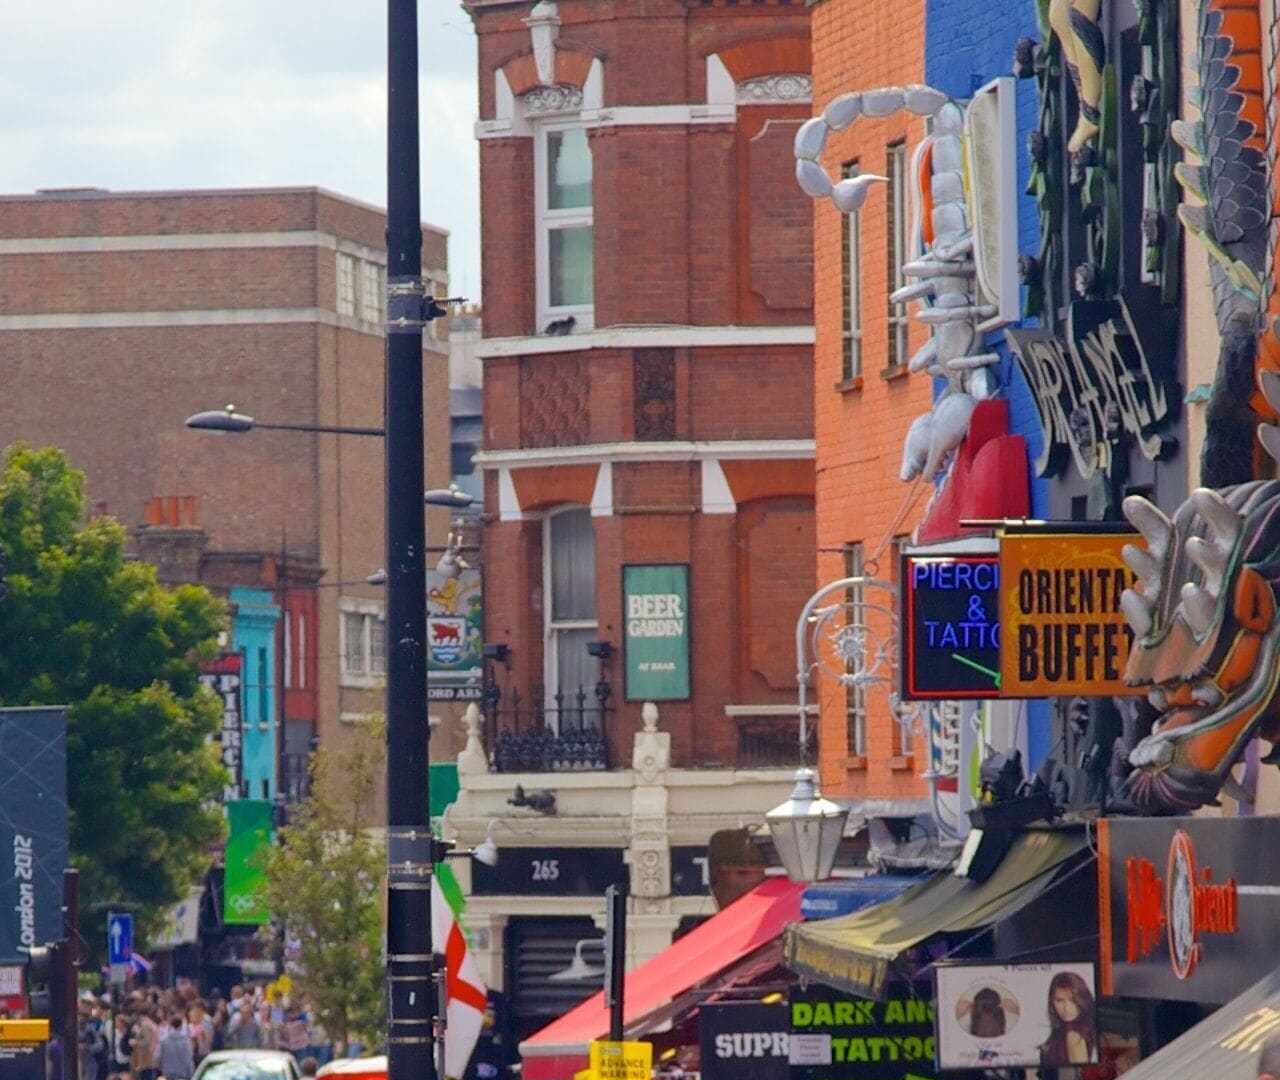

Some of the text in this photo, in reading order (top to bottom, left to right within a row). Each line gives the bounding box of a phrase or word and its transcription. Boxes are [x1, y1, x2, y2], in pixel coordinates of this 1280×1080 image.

[628, 594, 685, 618] BEER
[967, 594, 986, 621] &
[628, 619, 683, 637] GARDEN
[14, 835, 32, 880] 2012
[532, 860, 559, 881] 265
[792, 1001, 876, 1026] DARK
